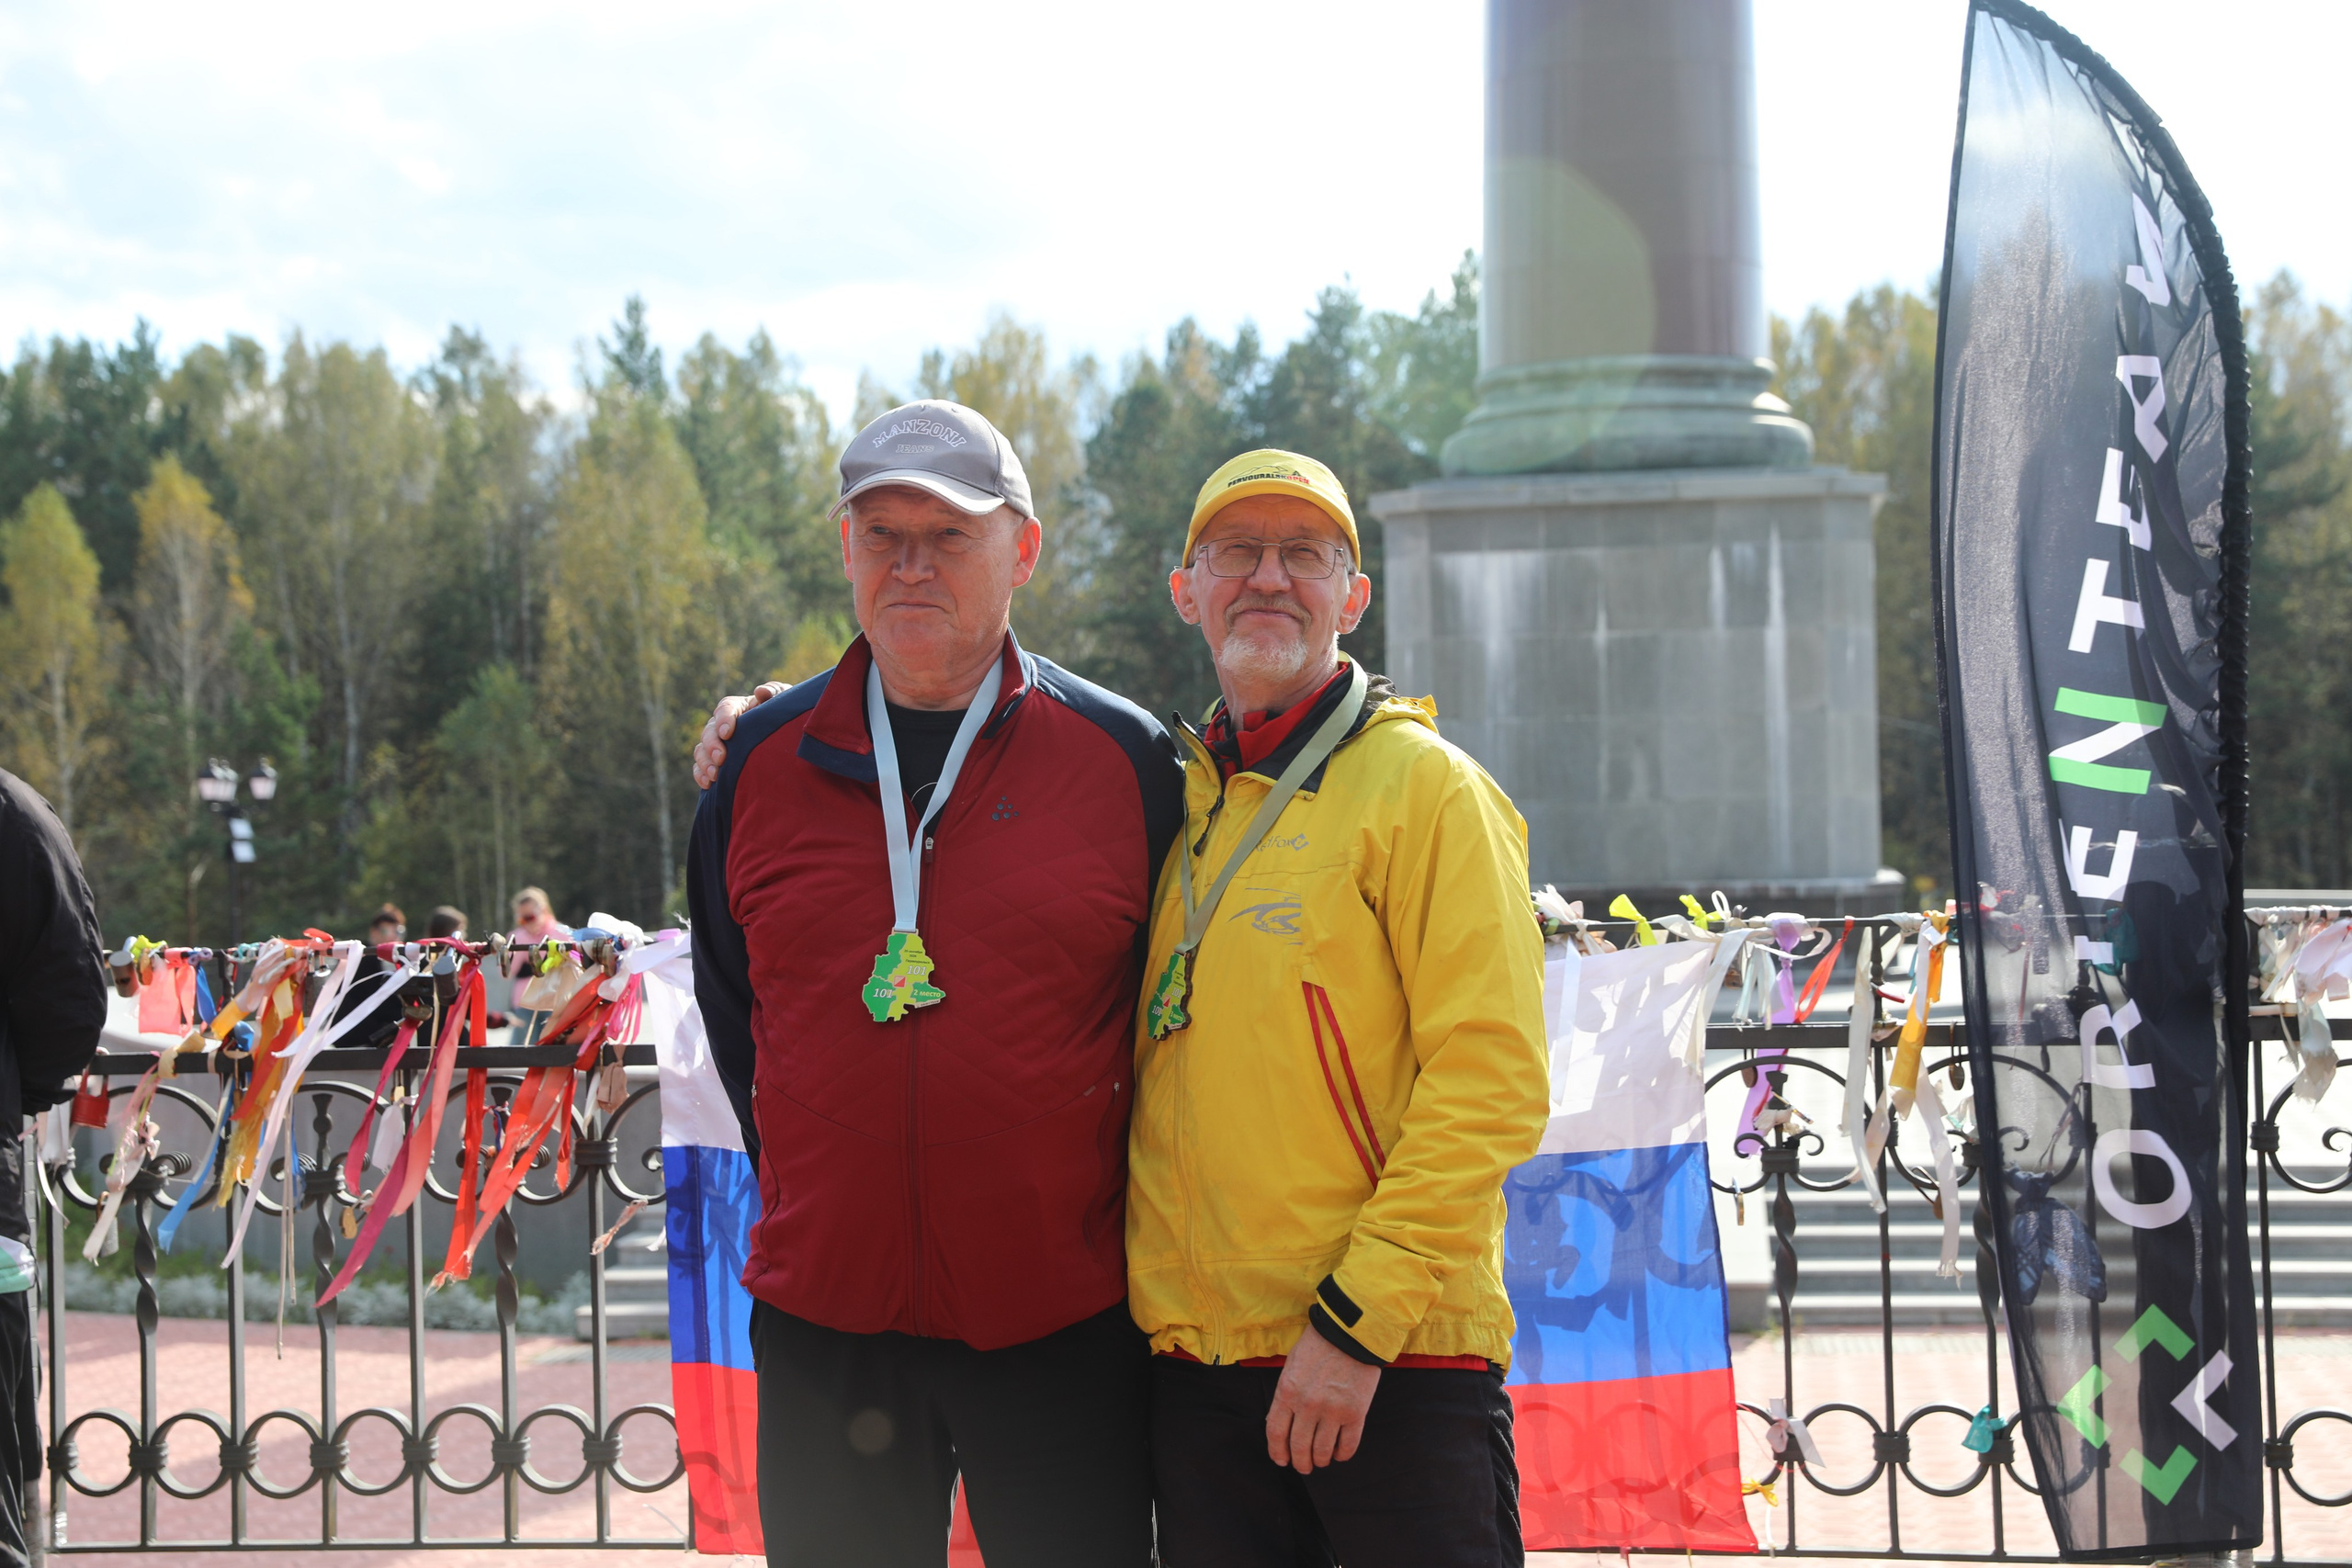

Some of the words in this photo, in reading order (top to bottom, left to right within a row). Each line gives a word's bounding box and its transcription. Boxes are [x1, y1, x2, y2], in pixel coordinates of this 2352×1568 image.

[872, 418, 967, 448] MANZONI
[895, 444, 935, 454] JEANS
[907, 965, 926, 976] 101
[873, 987, 894, 998] 101
